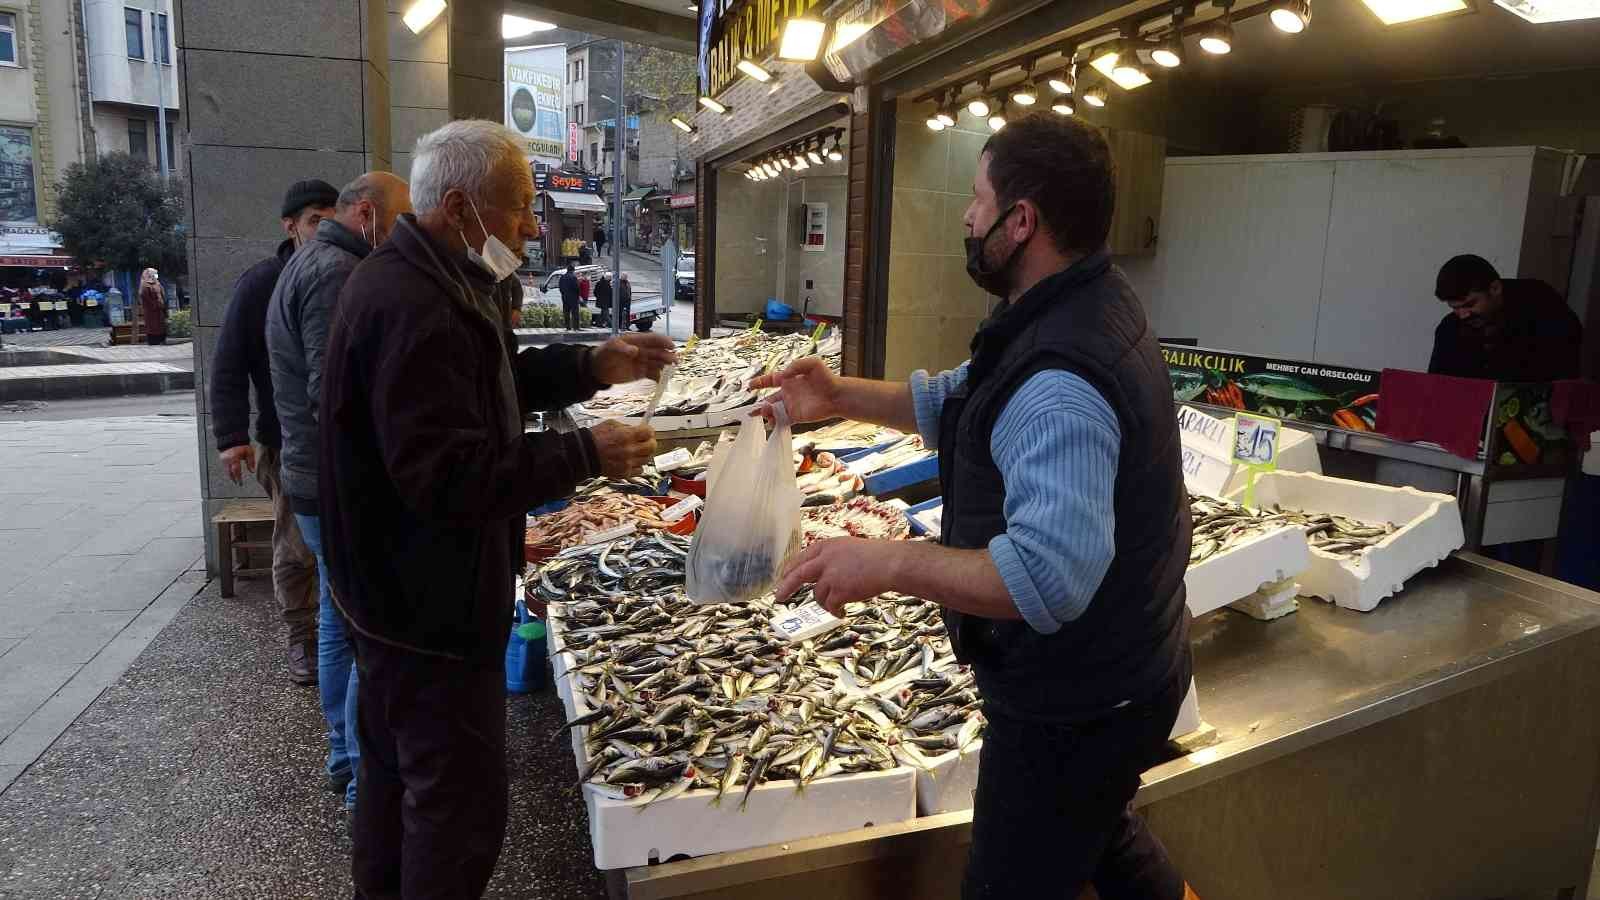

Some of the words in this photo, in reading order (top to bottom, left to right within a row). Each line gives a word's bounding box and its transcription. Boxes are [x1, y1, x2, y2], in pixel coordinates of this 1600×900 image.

[711, 16, 741, 97] BALIK
[1265, 362, 1299, 374] MEHMET
[1301, 367, 1318, 376] CAN
[1320, 368, 1371, 382] ÖRSELOĞLU
[1249, 425, 1276, 463] 15
